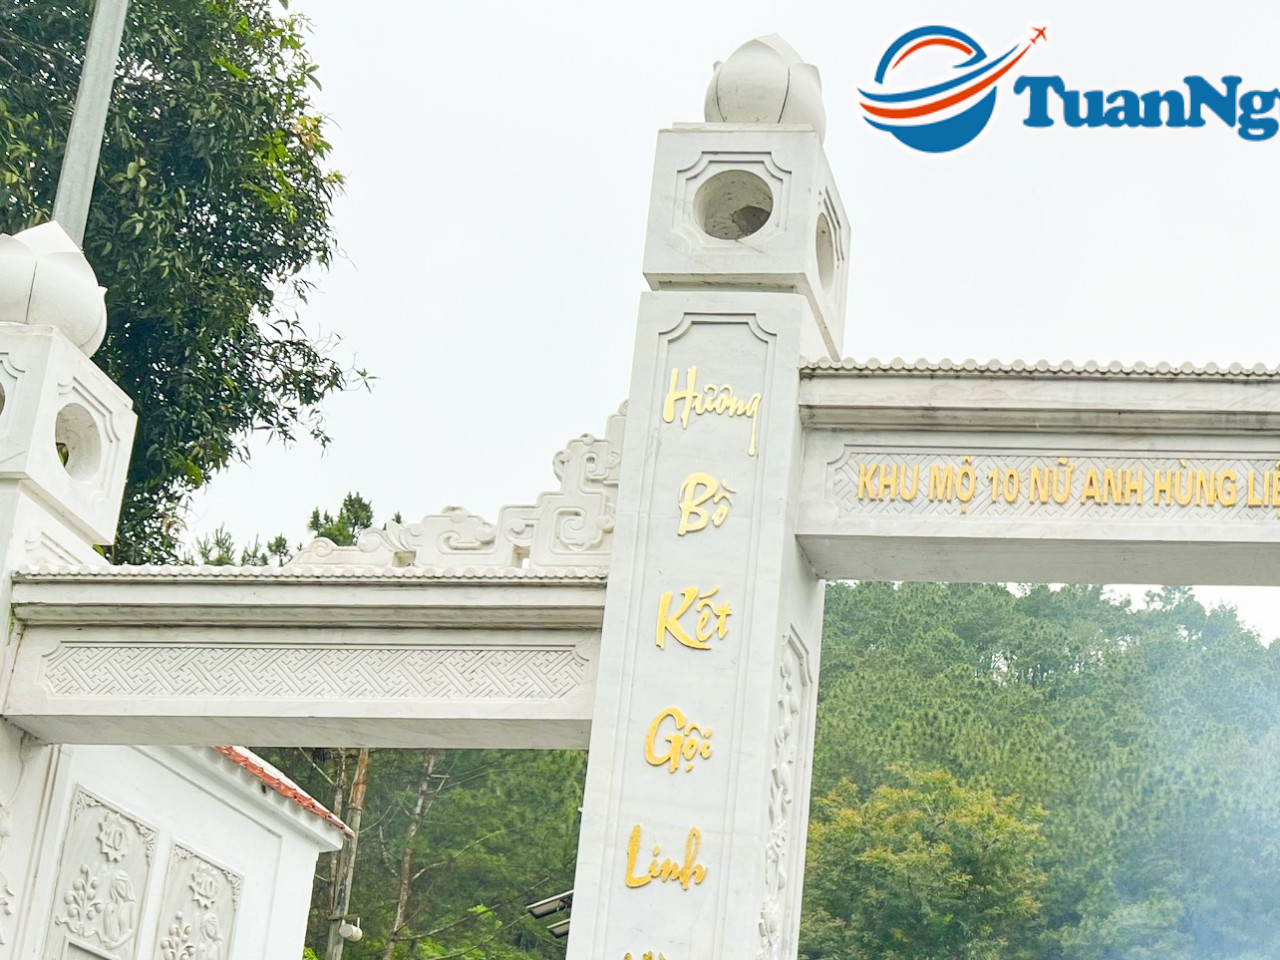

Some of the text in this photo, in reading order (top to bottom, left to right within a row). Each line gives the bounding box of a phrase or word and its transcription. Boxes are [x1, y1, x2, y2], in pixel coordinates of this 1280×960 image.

[676, 471, 737, 537] Bồ
[858, 464, 919, 501] KHU
[928, 455, 976, 514] MỘ
[988, 468, 1021, 504] 10
[1029, 456, 1075, 504] NỮ
[1080, 468, 1144, 504] ANH
[1154, 458, 1238, 508] HÙNG
[656, 586, 731, 649] Kết
[645, 707, 712, 774] Gọi
[625, 824, 707, 890] Linh
